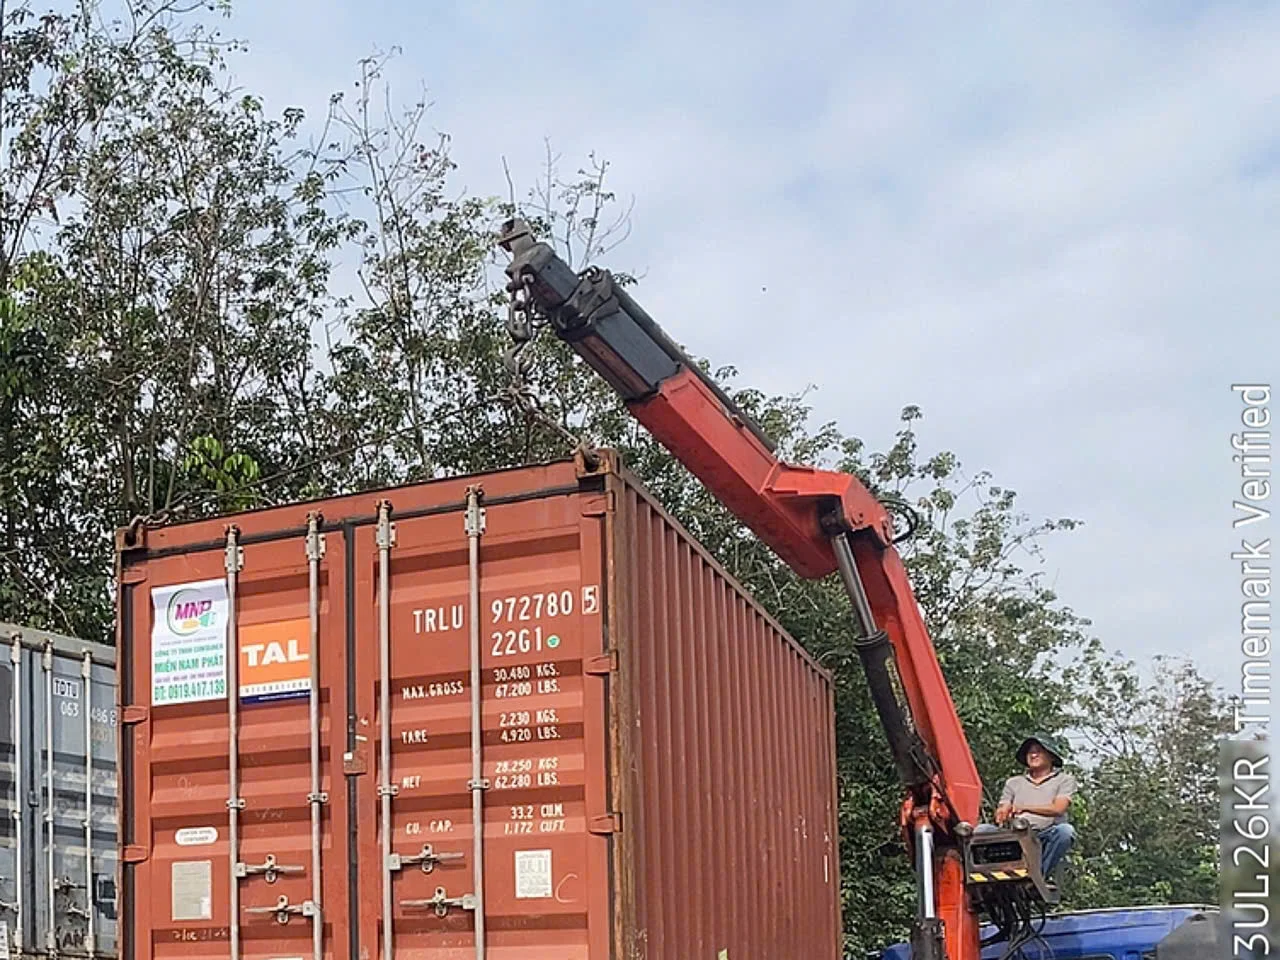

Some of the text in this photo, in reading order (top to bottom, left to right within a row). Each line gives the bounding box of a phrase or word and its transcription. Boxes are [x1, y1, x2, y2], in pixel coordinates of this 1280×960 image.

[174, 599, 212, 621] MNP
[412, 587, 597, 634] TRLU 972780 5
[491, 626, 543, 657] 22G1
[241, 639, 310, 667] TAL
[178, 659, 199, 670] NAM
[493, 663, 560, 682] 30.480 KGS.
[54, 679, 78, 697] TDTU
[168, 679, 225, 700] 0919.417.139
[402, 680, 464, 701] MAX.GROSS
[495, 679, 561, 699] 67.200 LBS.
[499, 709, 560, 727] 2.230 KGS.
[401, 729, 429, 745] TARE
[500, 726, 561, 743] 4.920 LBS.
[495, 759, 532, 774] 28.250
[402, 776, 422, 789] NET
[494, 772, 561, 789] 62.280 LBS.
[511, 804, 534, 820] 33.2
[430, 819, 454, 833] CAP.
[504, 821, 533, 835] 1.172
